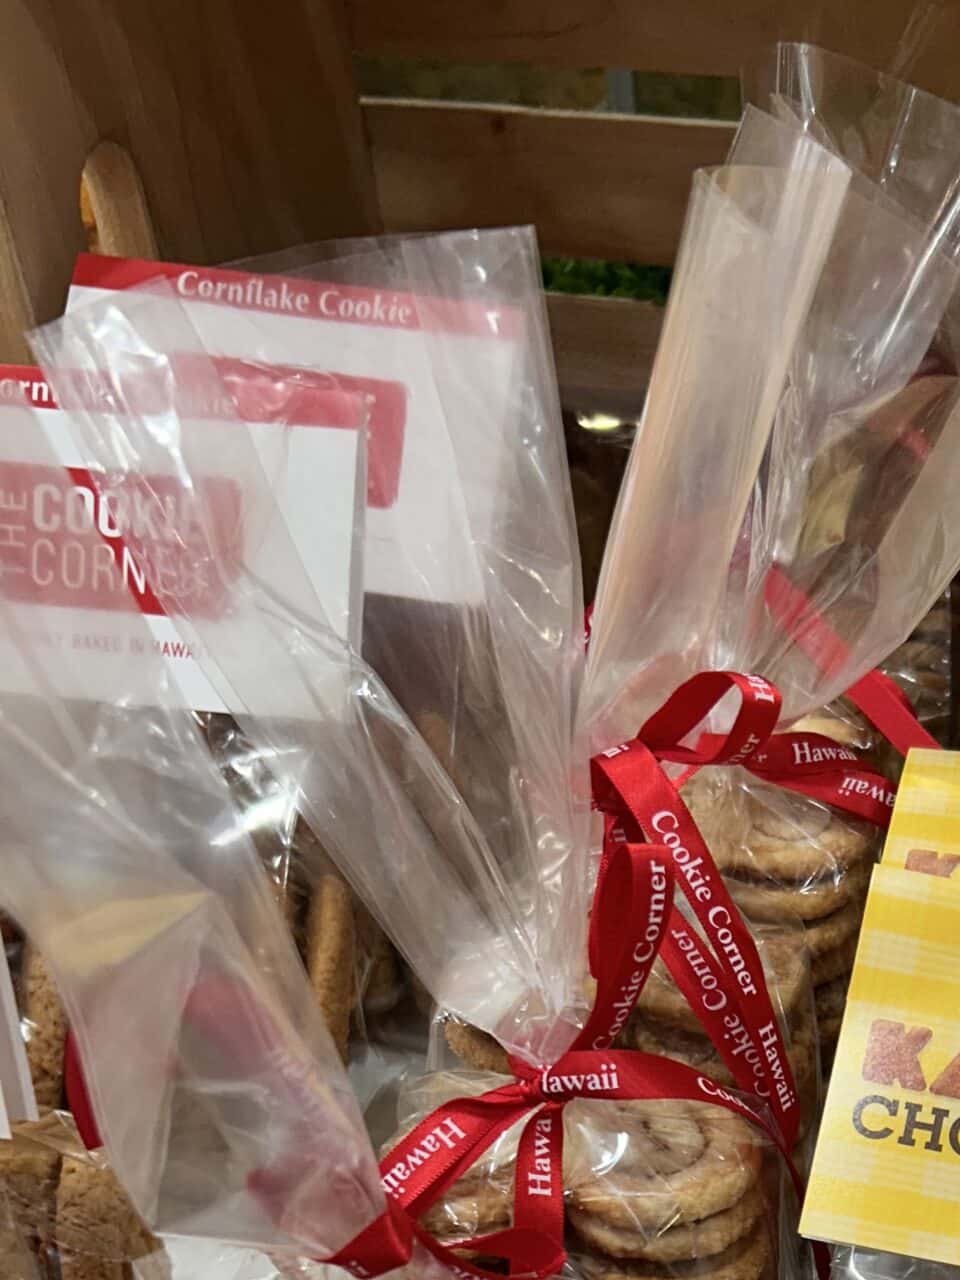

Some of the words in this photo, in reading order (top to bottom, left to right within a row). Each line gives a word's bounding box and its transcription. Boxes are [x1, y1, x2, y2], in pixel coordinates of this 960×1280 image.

[176, 270, 310, 315] Cornflake
[318, 289, 413, 324] Cookie
[835, 776, 896, 809] awaii
[633, 858, 668, 965] Corner
[651, 809, 713, 903] Cookie
[707, 904, 758, 998] Corner
[757, 1018, 796, 1114] Hawaii
[671, 928, 728, 1013] Corner
[381, 1116, 467, 1200] Hawaii
[527, 1118, 553, 1197] Hawa
